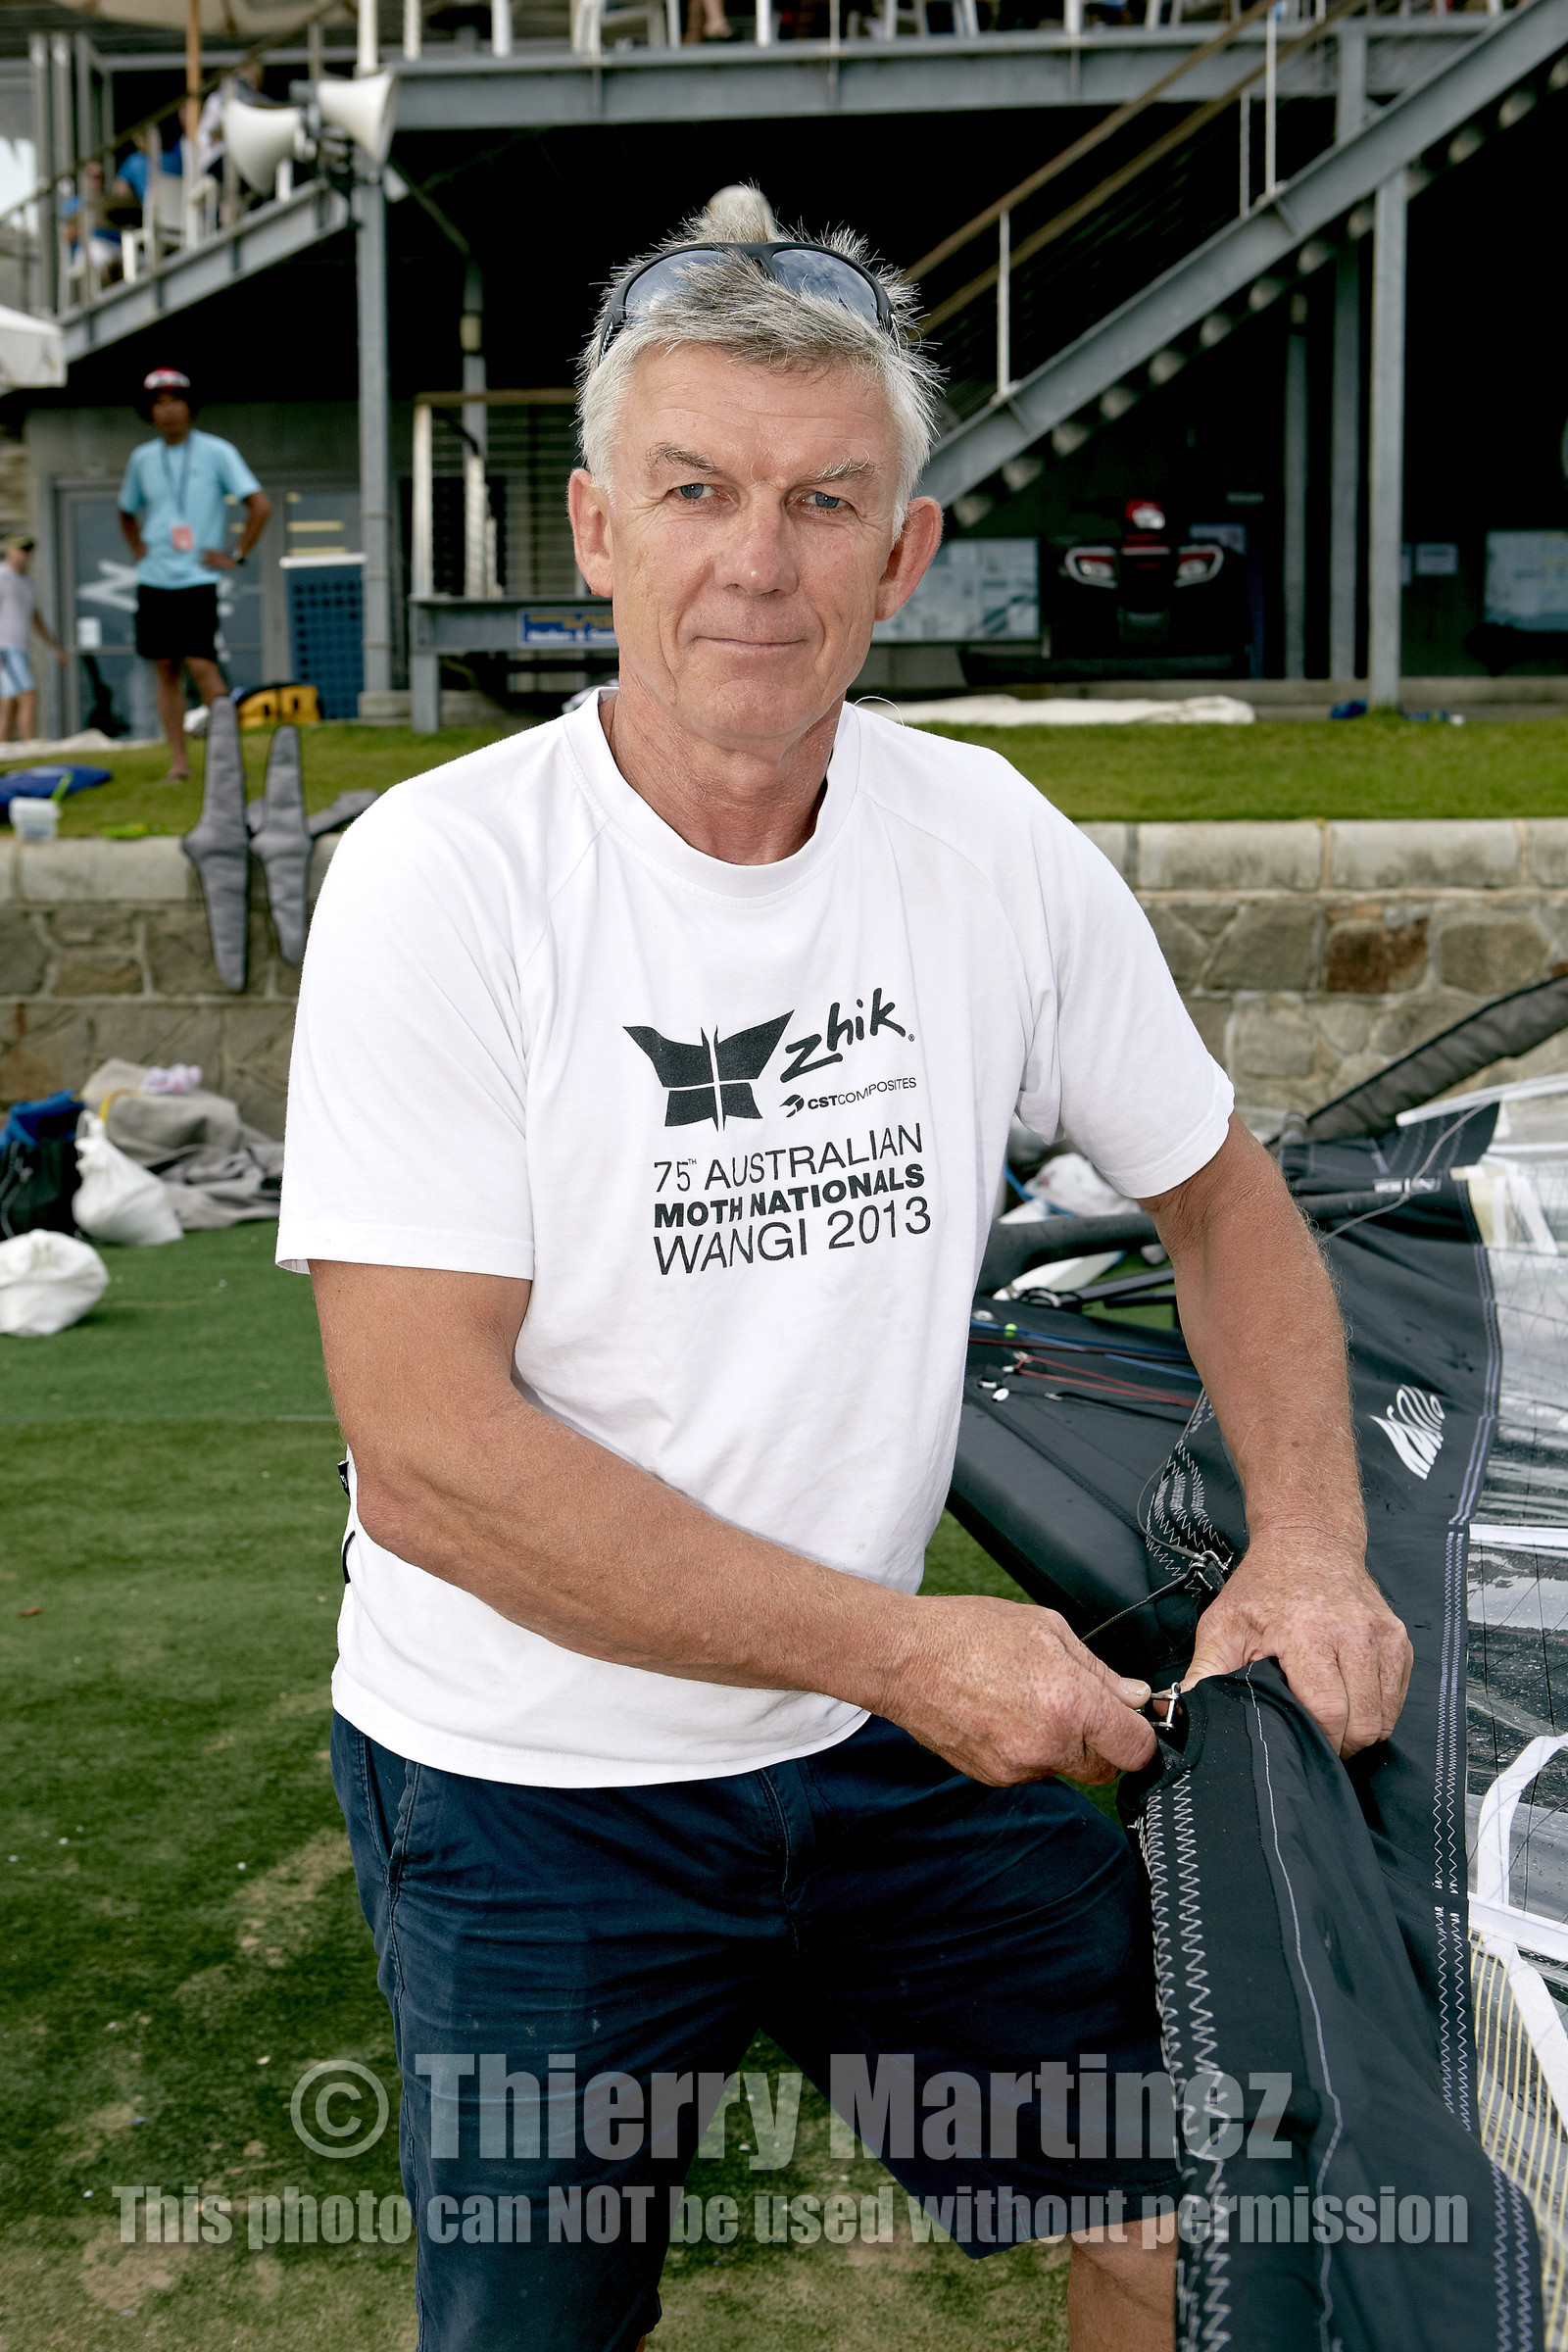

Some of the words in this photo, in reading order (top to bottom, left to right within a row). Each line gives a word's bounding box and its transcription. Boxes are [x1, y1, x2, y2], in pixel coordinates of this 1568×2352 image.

[705, 1123, 922, 1190] AUSTRALIAN
[654, 1198, 743, 1228] MOTH
[750, 1163, 925, 1217] NATIONALS
[654, 1218, 807, 1275] WANGI
[827, 1196, 931, 1250] 2013
